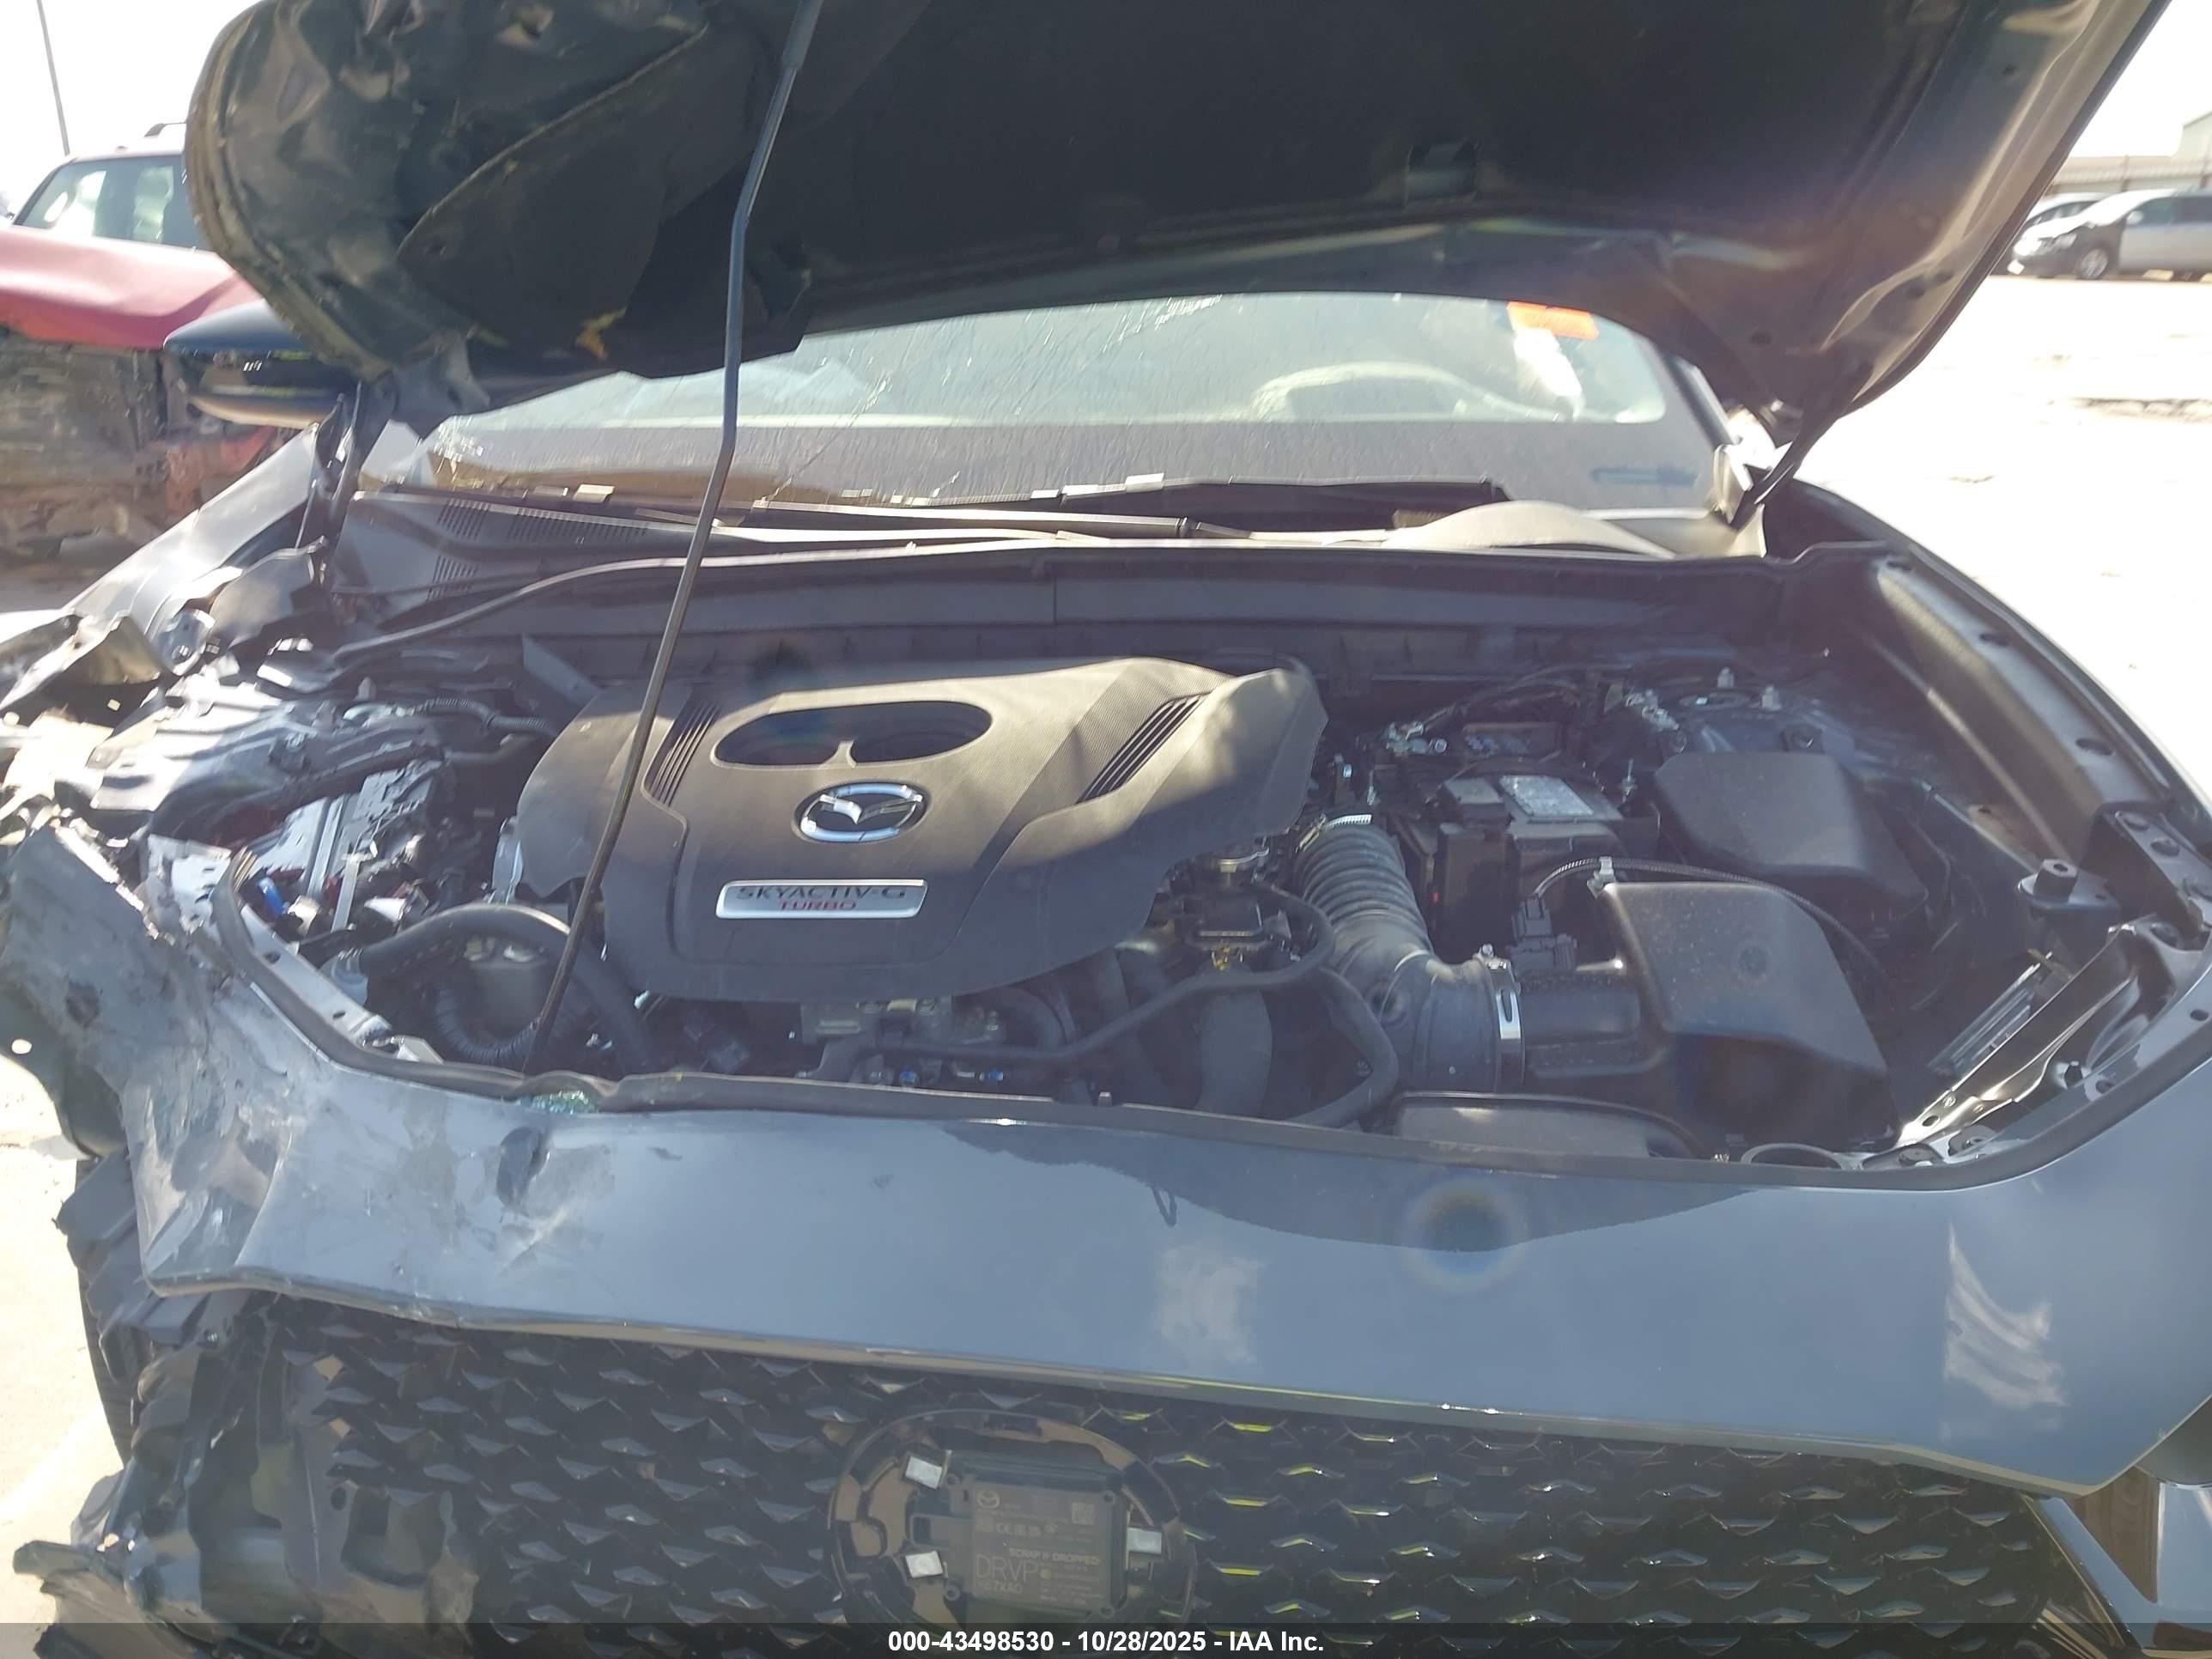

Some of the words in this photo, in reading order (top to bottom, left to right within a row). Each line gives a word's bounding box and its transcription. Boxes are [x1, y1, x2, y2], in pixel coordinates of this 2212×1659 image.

[737, 885, 906, 900] SKYACTIV-G
[779, 899, 858, 911] TURBO
[975, 1553, 1040, 1583] DRVP
